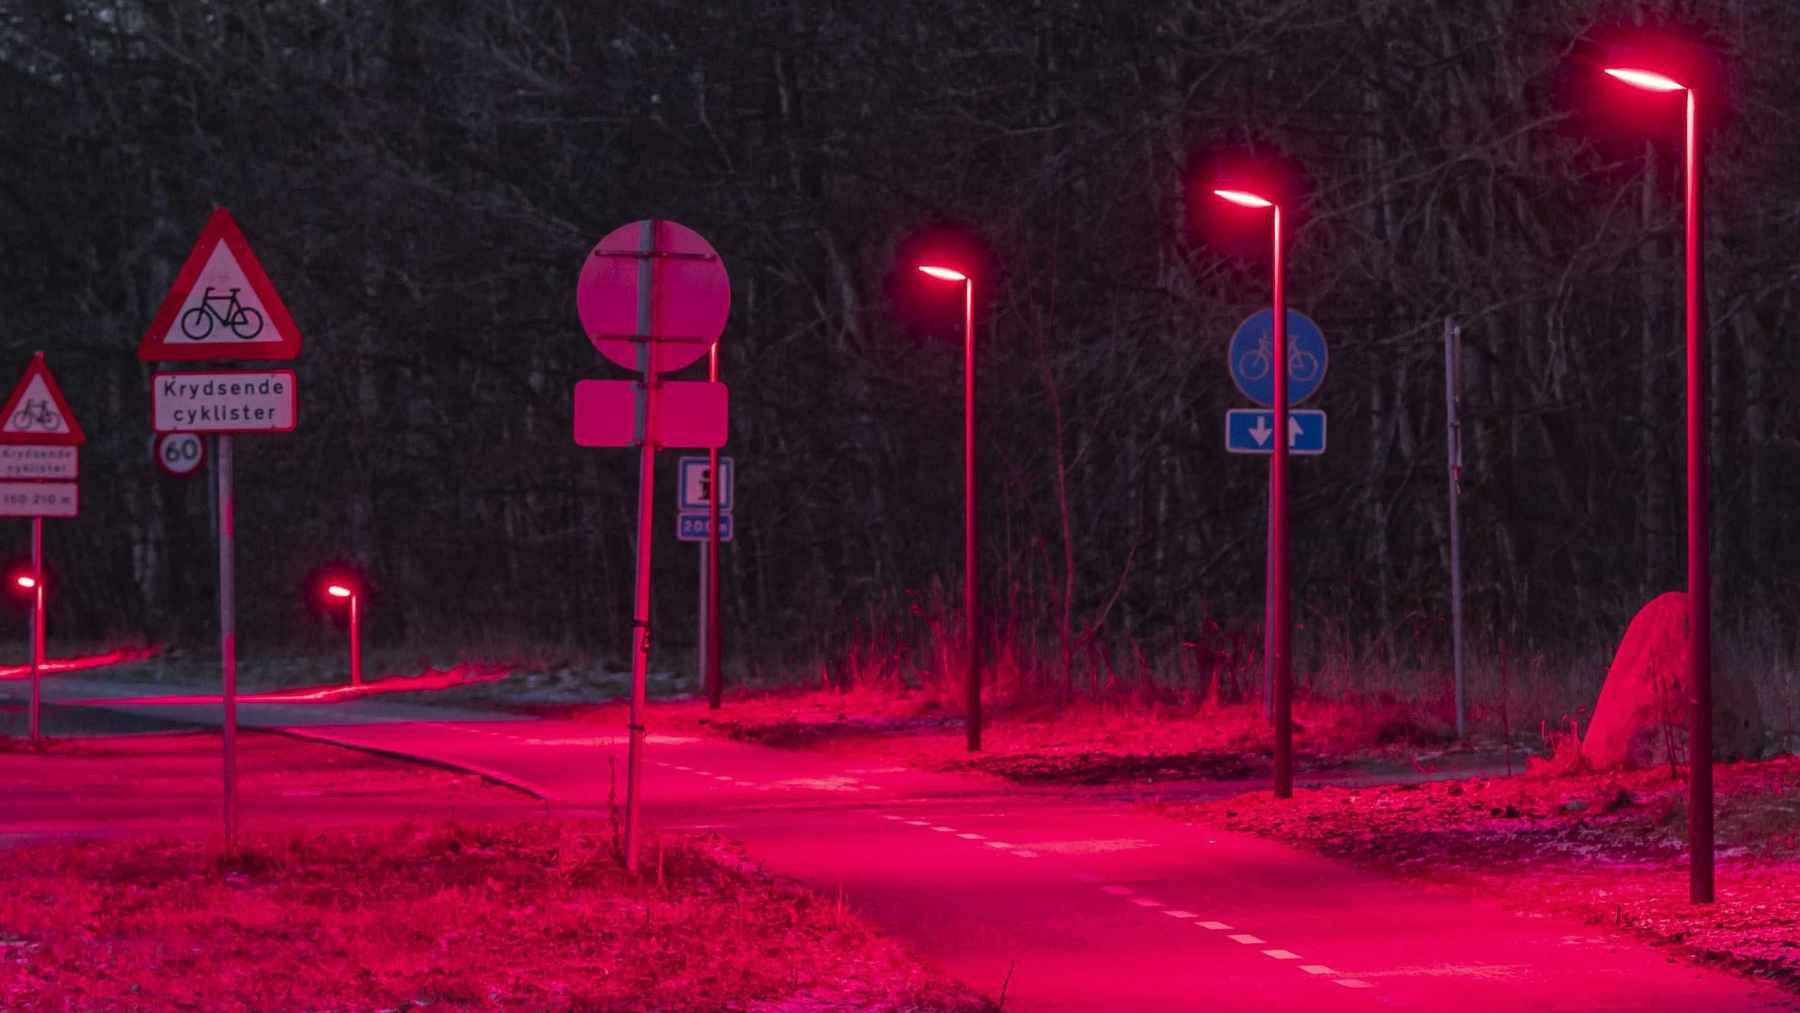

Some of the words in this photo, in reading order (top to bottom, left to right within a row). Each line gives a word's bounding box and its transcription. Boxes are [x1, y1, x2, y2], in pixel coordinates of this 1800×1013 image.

[163, 379, 284, 400] Krydsende
[173, 404, 275, 425] cyklister
[165, 439, 198, 462] 60
